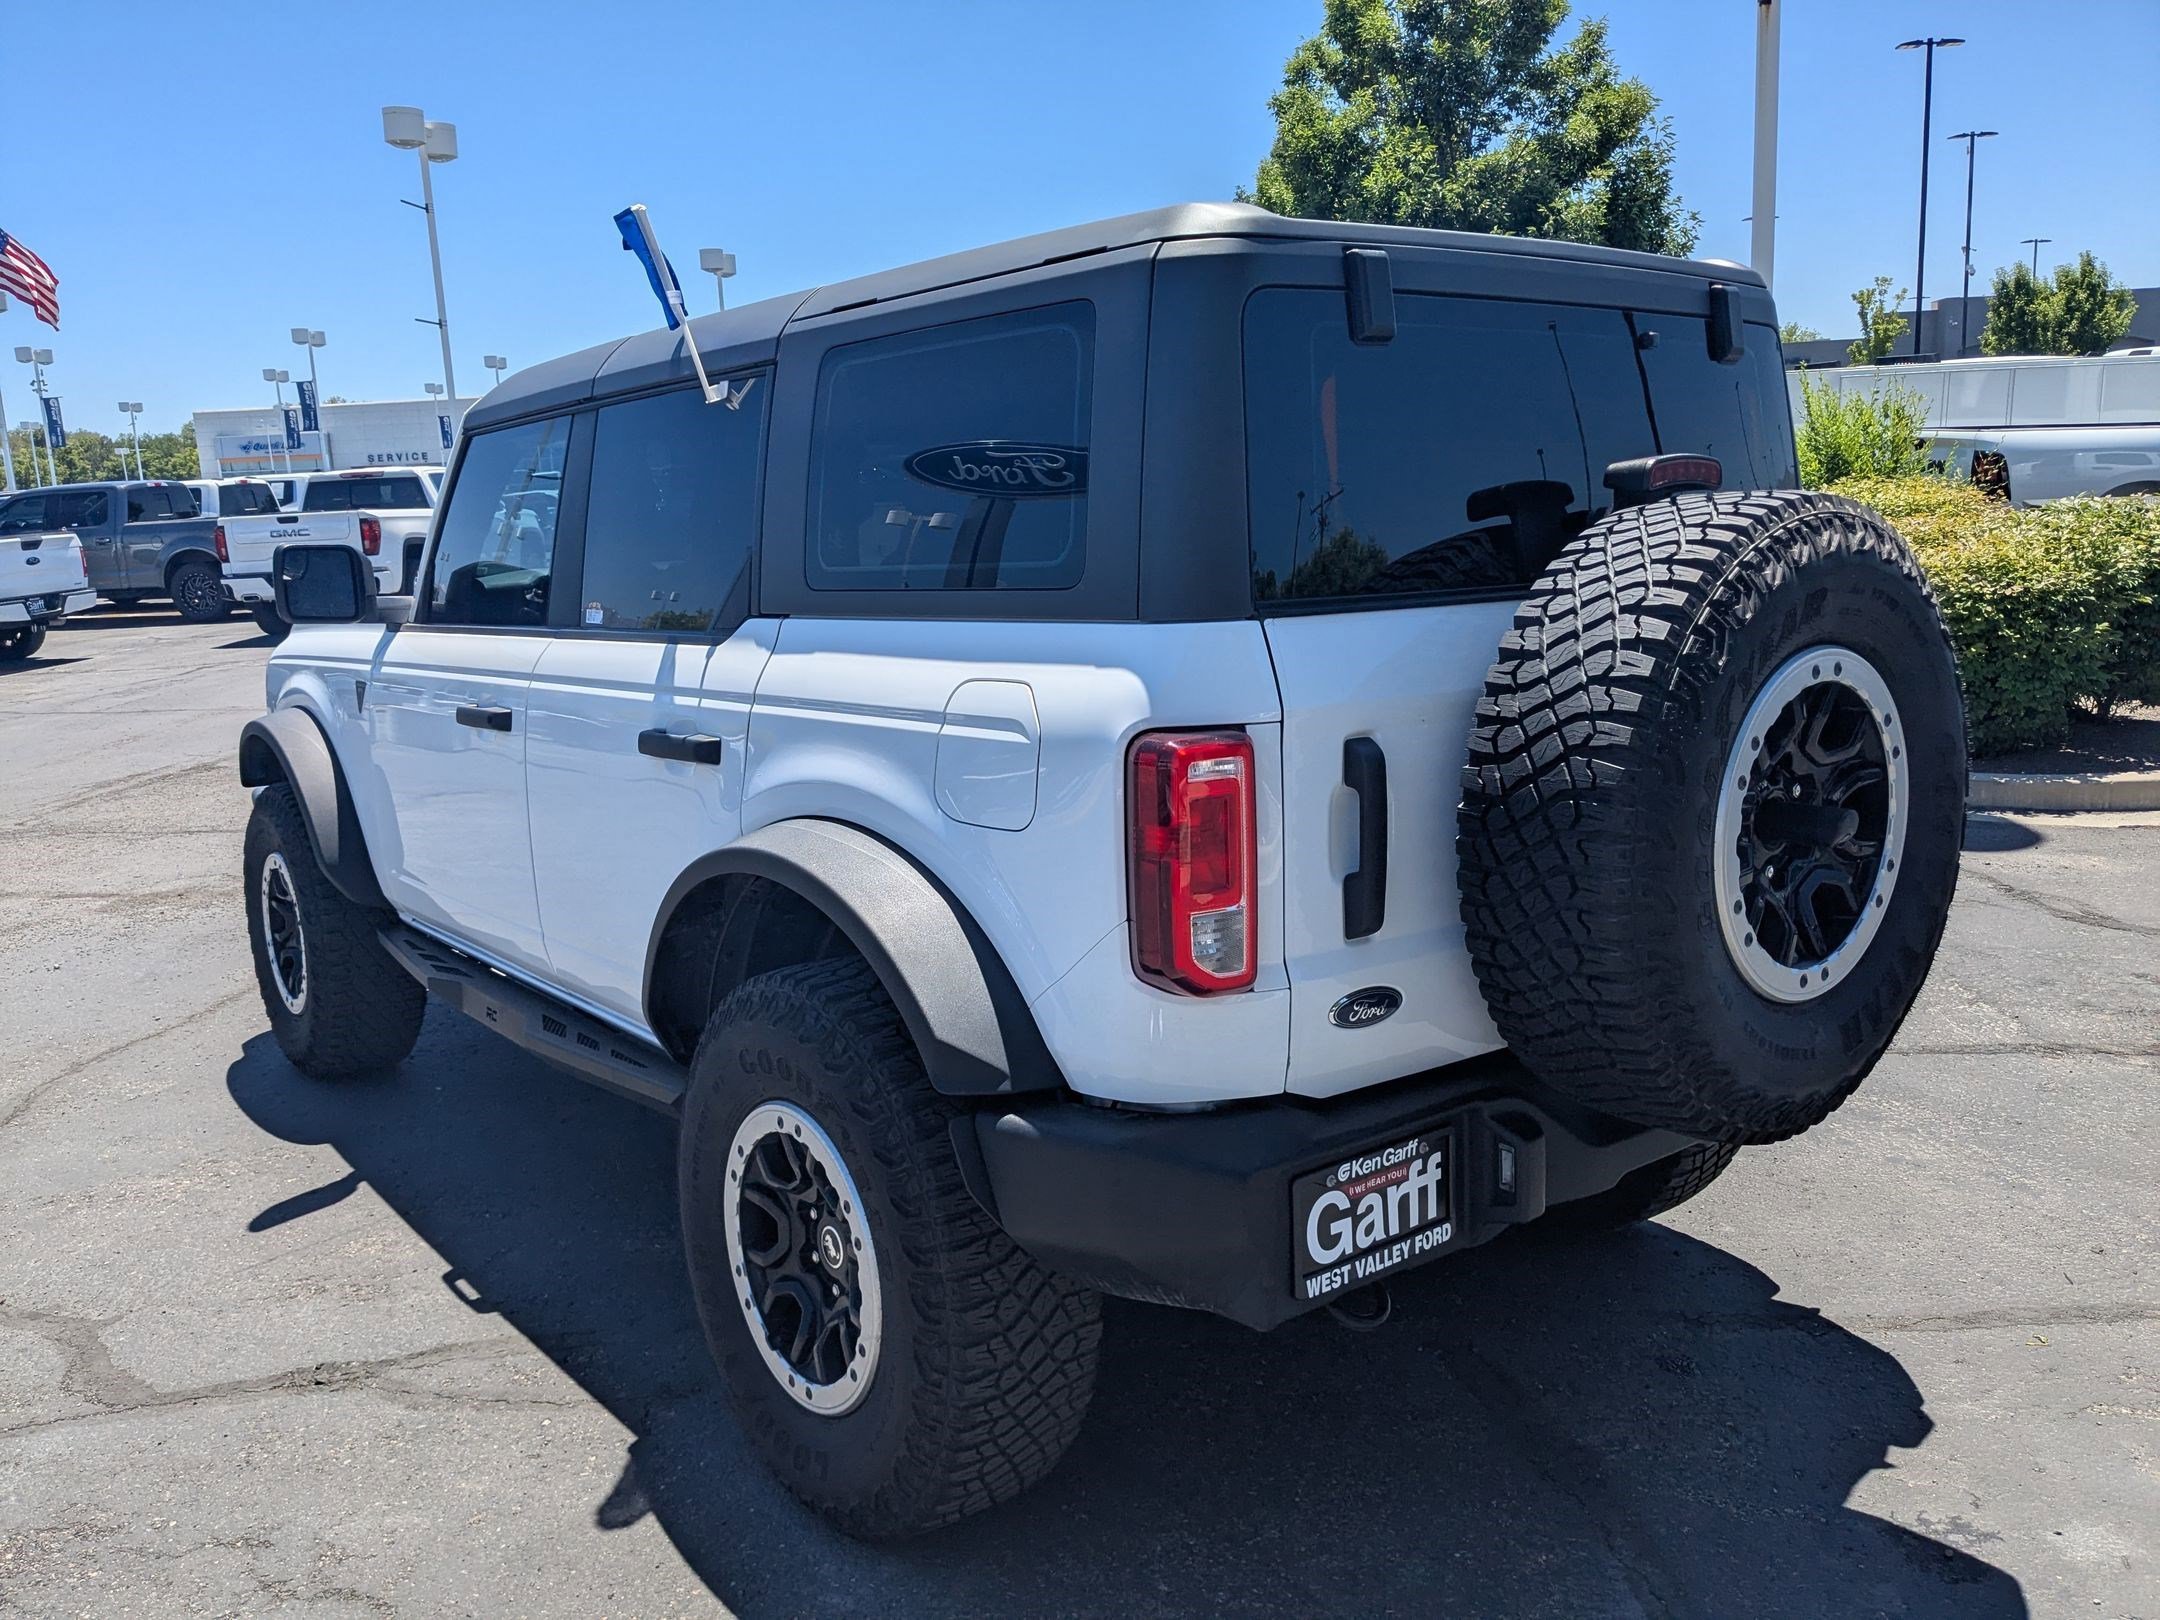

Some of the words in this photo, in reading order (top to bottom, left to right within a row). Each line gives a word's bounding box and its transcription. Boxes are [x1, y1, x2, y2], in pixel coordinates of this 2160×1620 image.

[252, 441, 280, 451] Quik
[367, 451, 429, 463] SERVICE
[269, 528, 311, 538] GMC
[1349, 998, 1389, 1022] Ford
[1351, 1157, 1381, 1178] Ken
[1382, 1138, 1419, 1167] Garff
[1366, 1175, 1386, 1189] HEAR
[1387, 1169, 1402, 1180] YOU
[1306, 1151, 1442, 1265] Garff
[1306, 1263, 1351, 1299] WEST
[1355, 1239, 1411, 1279] VALLEY
[1414, 1223, 1452, 1255] FORD
